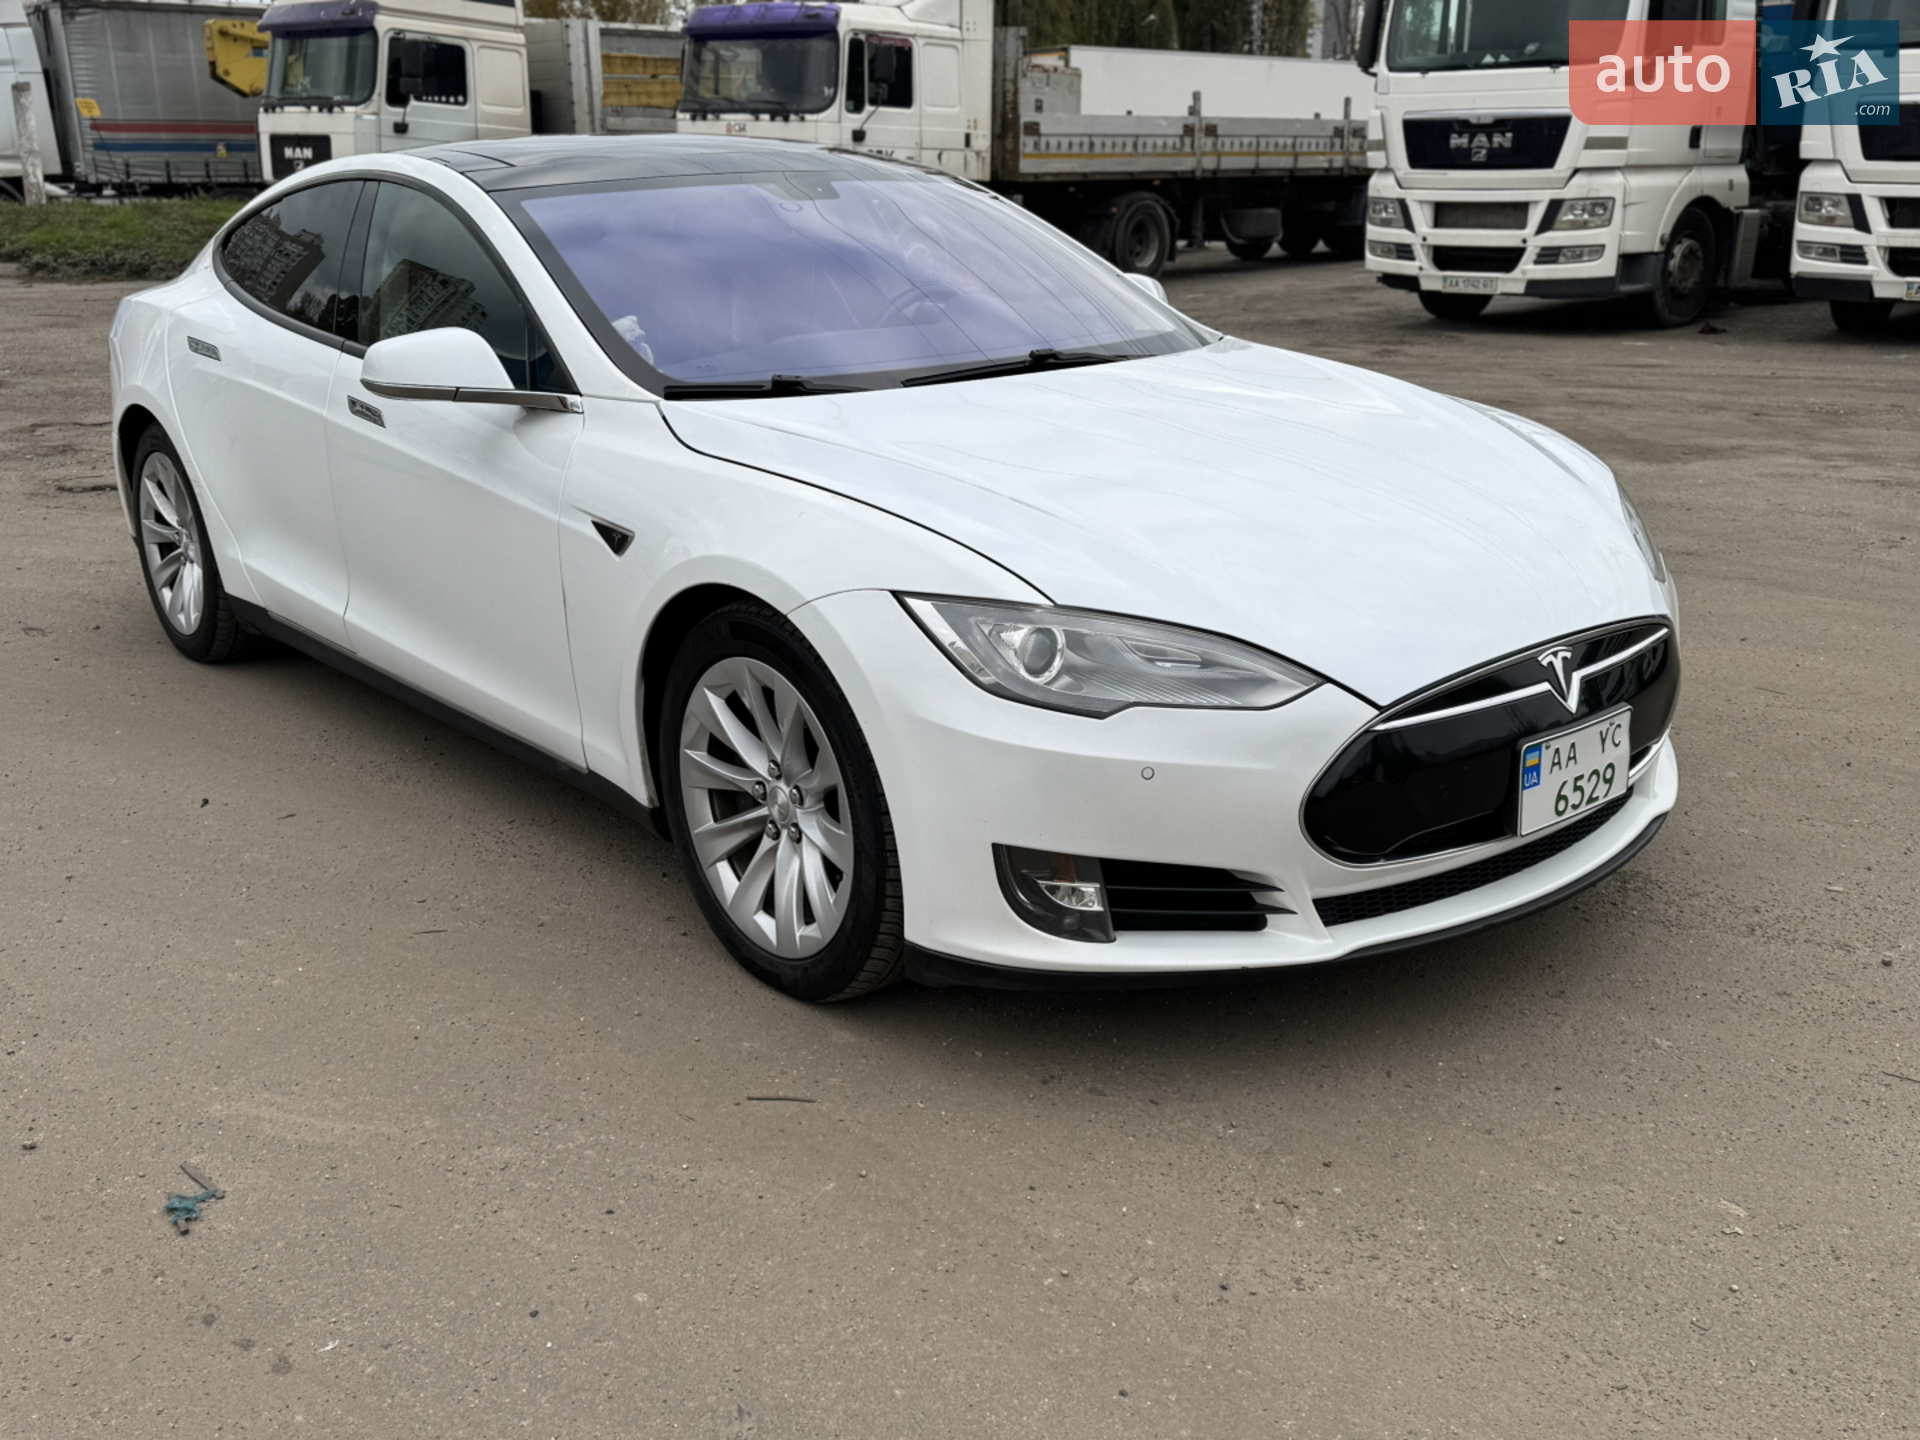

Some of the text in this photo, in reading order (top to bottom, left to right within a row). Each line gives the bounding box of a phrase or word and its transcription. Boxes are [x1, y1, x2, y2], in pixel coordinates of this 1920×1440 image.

[1450, 132, 1513, 149] MAN
[283, 146, 313, 160] MAN
[1549, 723, 1622, 775] AA YC
[1524, 771, 1538, 787] UA
[1554, 762, 1615, 816] 6529
